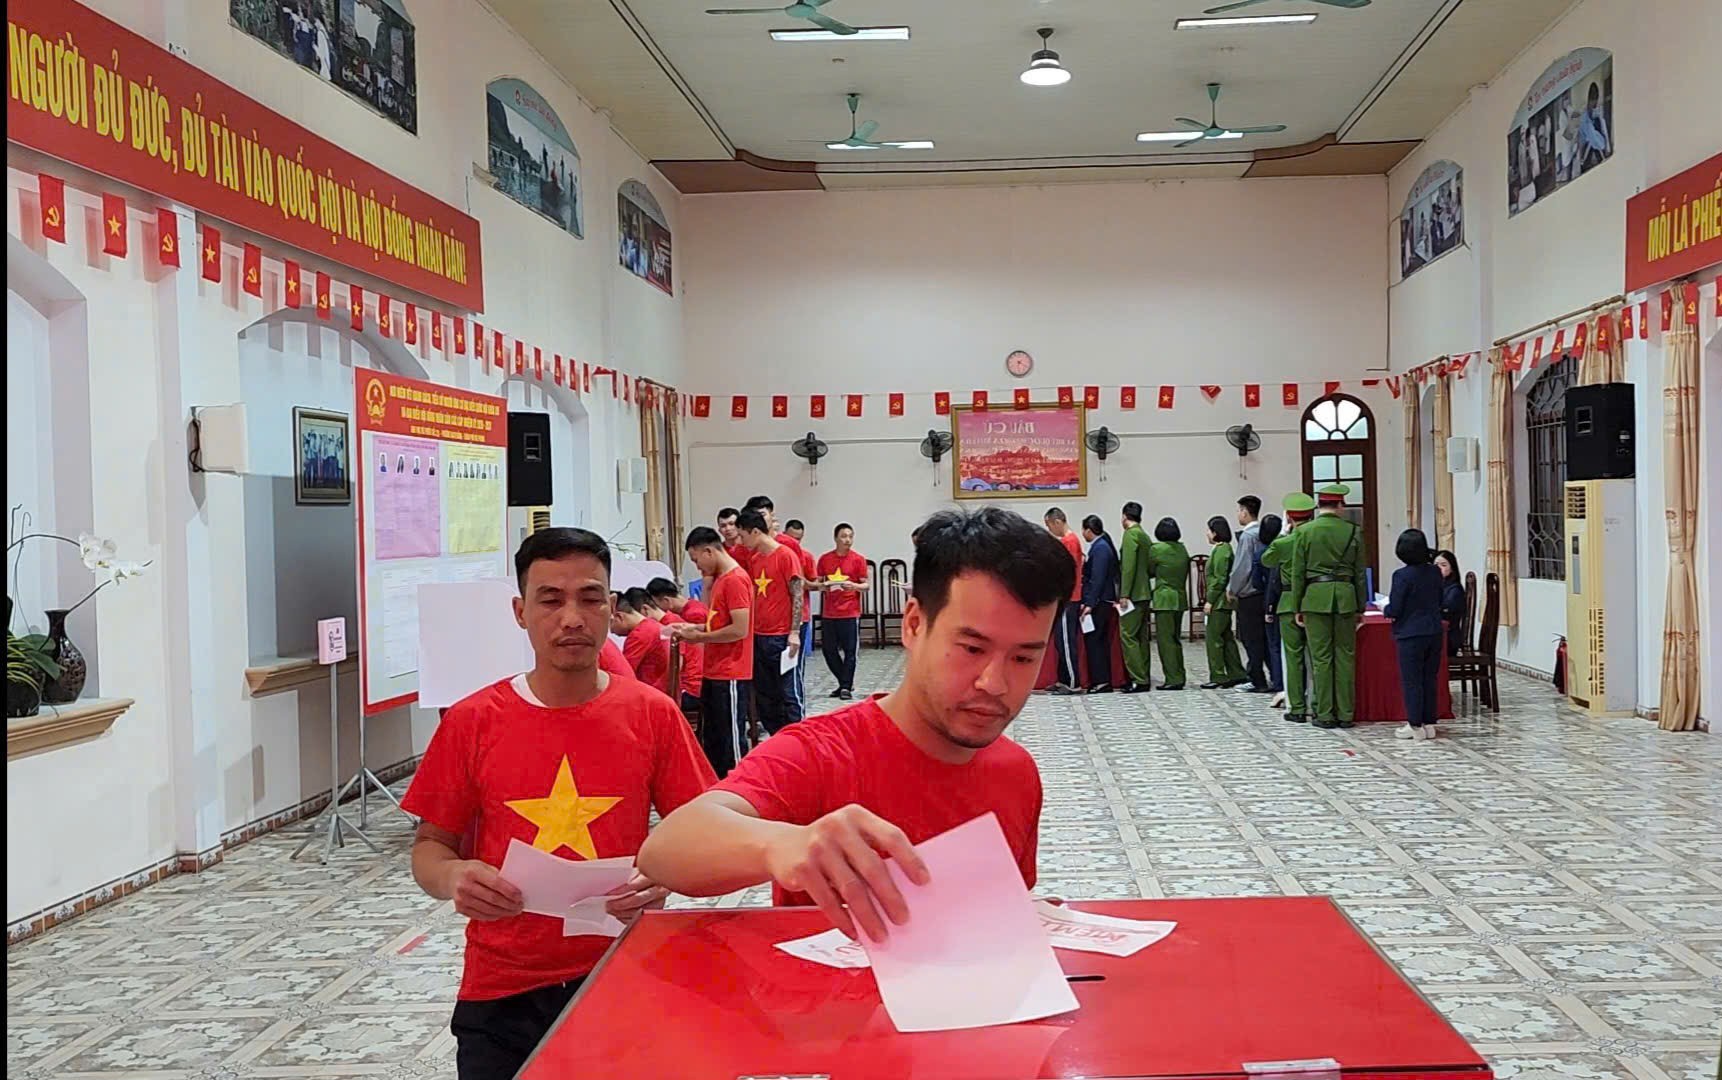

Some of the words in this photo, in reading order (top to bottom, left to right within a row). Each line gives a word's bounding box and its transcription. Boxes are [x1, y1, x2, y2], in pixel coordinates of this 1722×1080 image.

[8, 21, 88, 129] NGƯỜI
[93, 48, 125, 143] ĐỦ
[129, 75, 178, 174] ĐỨC,
[181, 92, 208, 178] ĐỦ
[210, 113, 239, 192] TÀI
[241, 128, 274, 206] VÀO
[277, 145, 316, 224] QUỐC
[317, 167, 342, 245] HỘI
[342, 179, 362, 243] VÀ
[361, 189, 384, 261] HỘI
[383, 194, 415, 265] ĐỒNG
[415, 217, 444, 276] NHÂN
[1673, 194, 1689, 253] LÁ
[1691, 171, 1722, 246] PHIẾ
